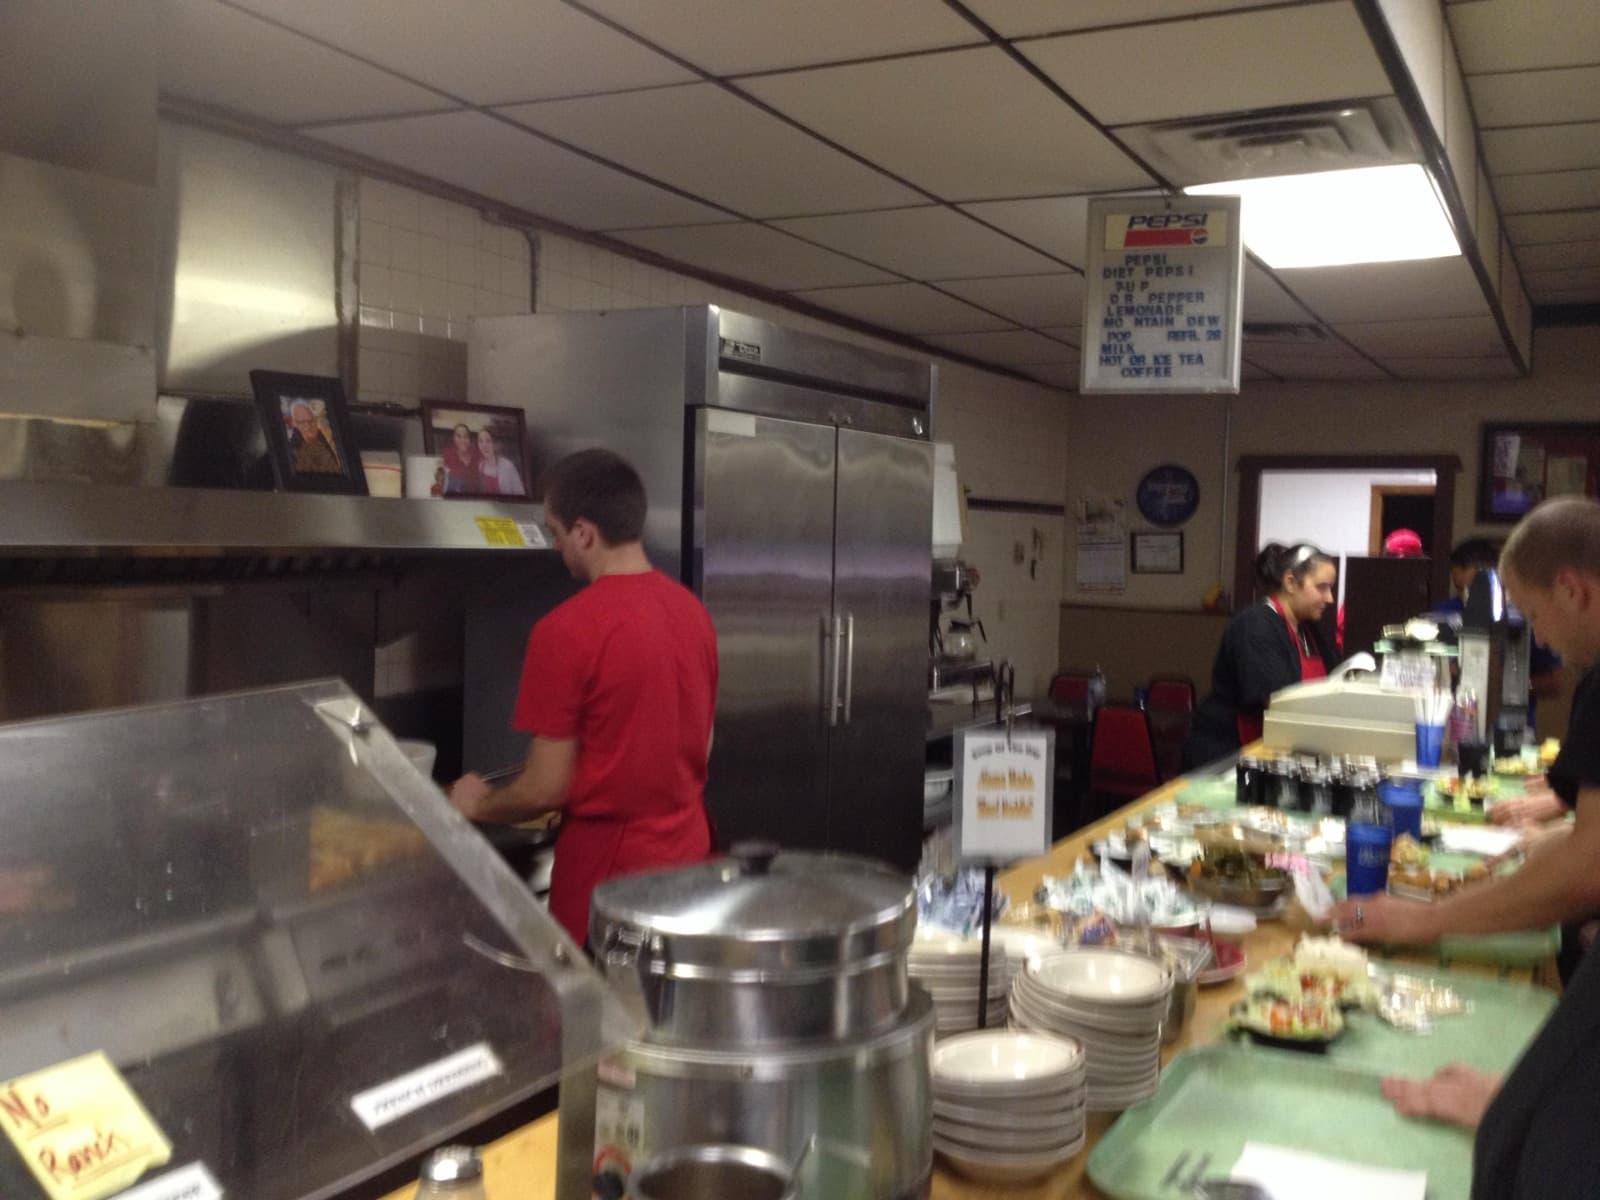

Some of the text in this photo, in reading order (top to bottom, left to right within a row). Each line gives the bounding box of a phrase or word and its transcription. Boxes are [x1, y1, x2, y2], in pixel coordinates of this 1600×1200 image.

[1127, 213, 1208, 229] PEPSI
[1124, 254, 1167, 266] PEPSI
[1102, 264, 1193, 279] DIET PEPSI
[1148, 291, 1204, 303] PEPPER
[1107, 304, 1184, 317] LEMONADE
[1187, 315, 1220, 327] DEW
[1101, 343, 1135, 355] MILK
[1100, 355, 1123, 366] HOT
[1129, 354, 1146, 366] OR
[1178, 353, 1204, 365] TEA
[1121, 366, 1172, 378] COFFEE
[0, 1082, 49, 1129] No
